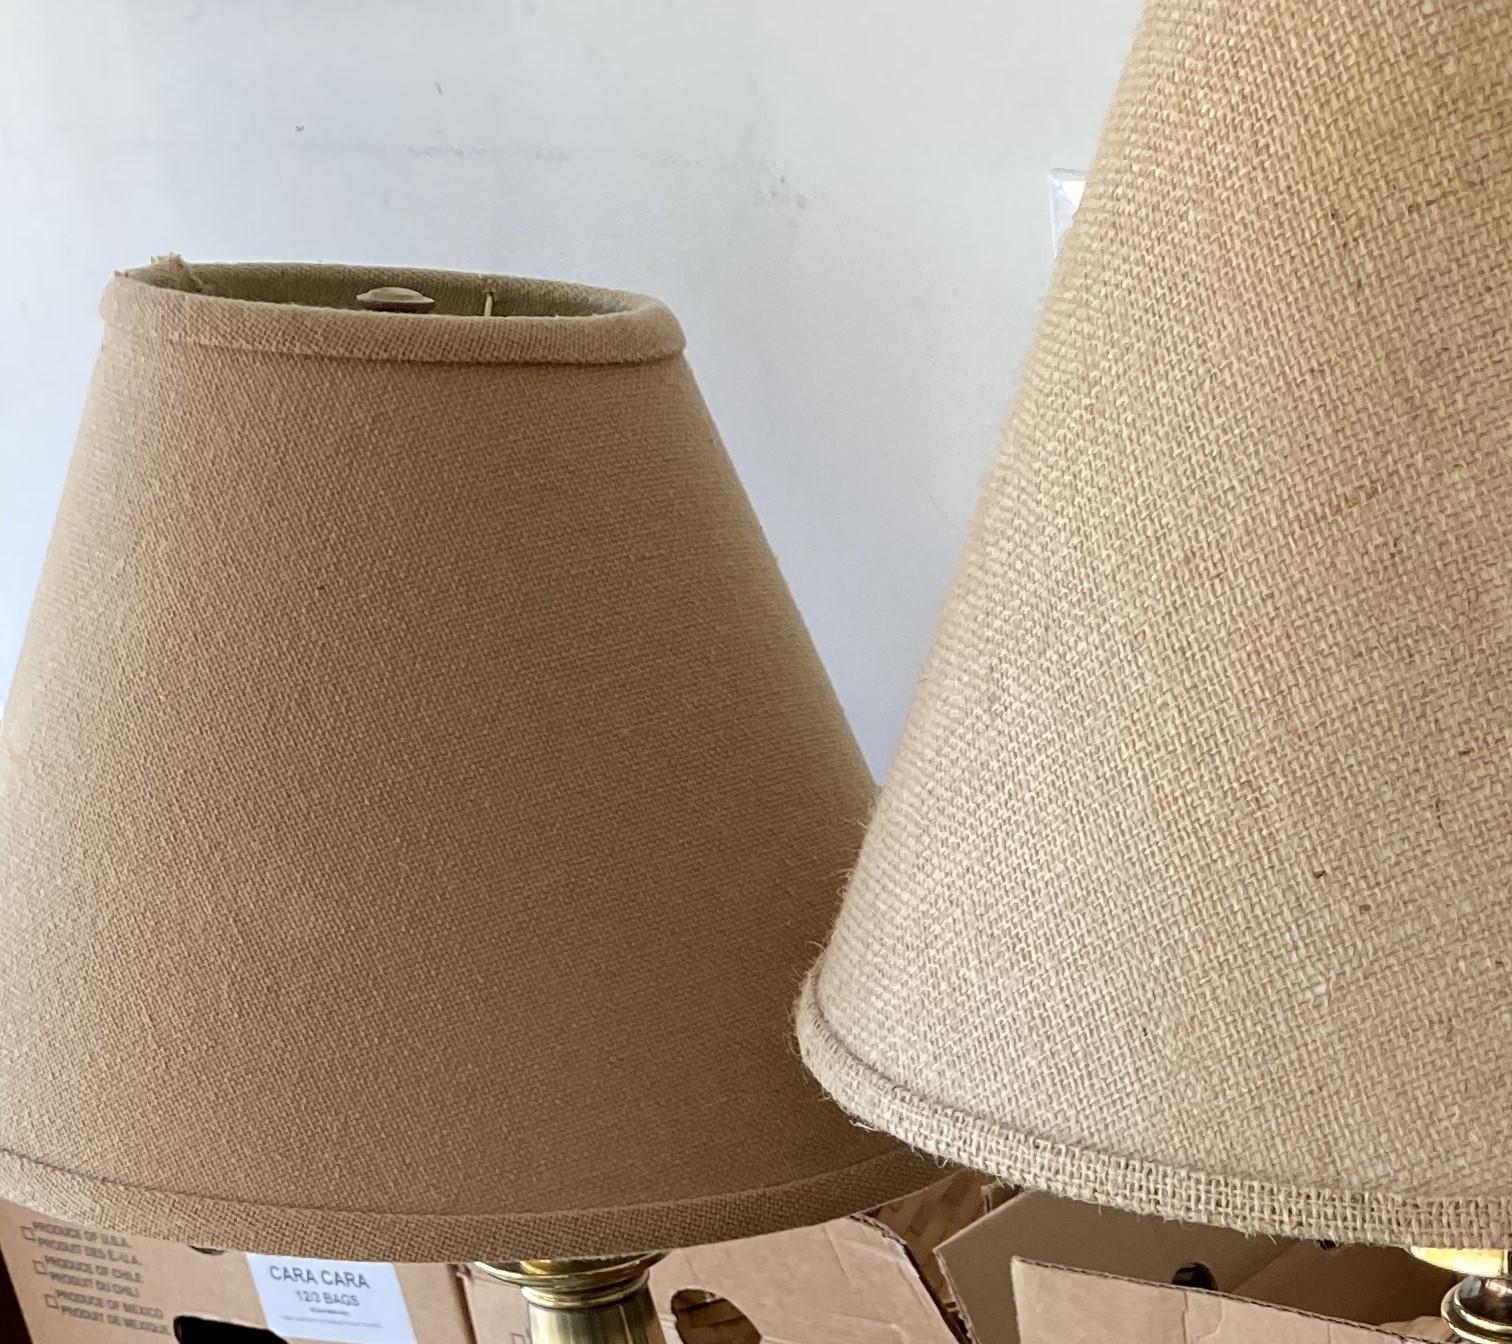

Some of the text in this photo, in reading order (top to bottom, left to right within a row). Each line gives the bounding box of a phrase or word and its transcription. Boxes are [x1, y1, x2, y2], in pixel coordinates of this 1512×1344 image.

[269, 1265, 370, 1289] CARA CARA
[323, 1292, 360, 1307] BAGS
